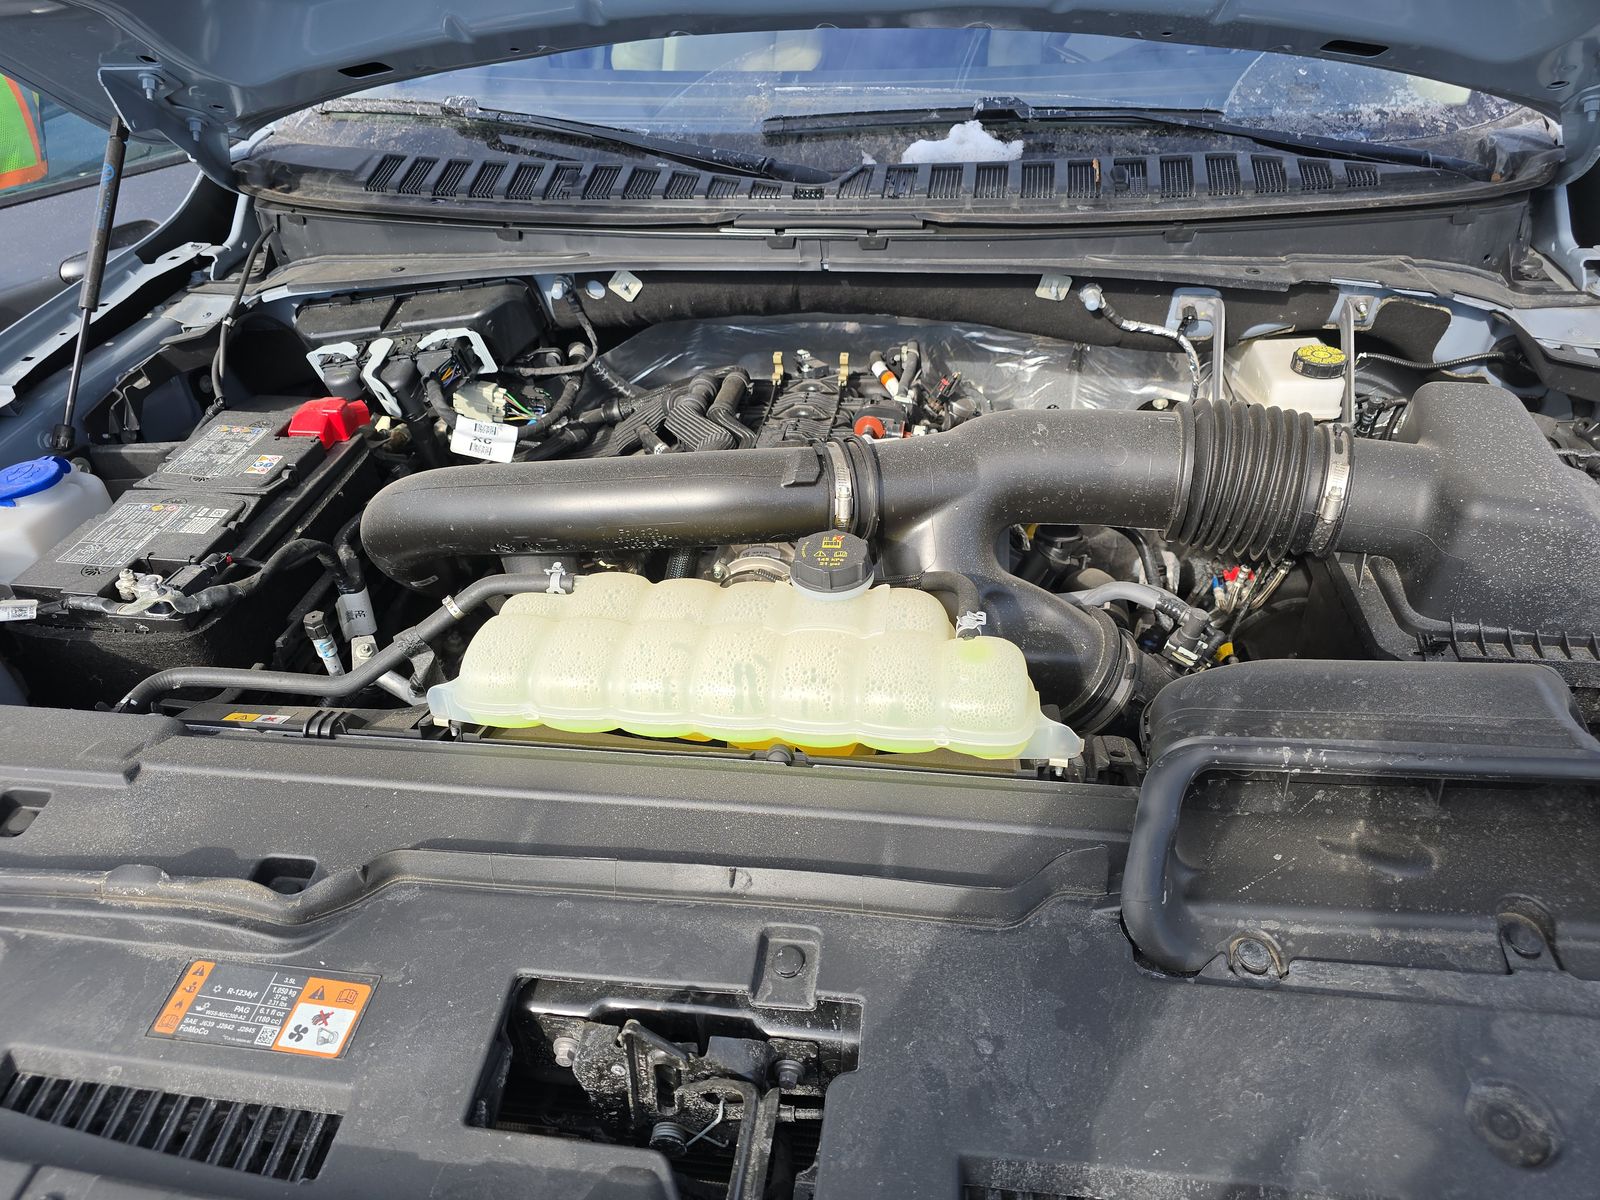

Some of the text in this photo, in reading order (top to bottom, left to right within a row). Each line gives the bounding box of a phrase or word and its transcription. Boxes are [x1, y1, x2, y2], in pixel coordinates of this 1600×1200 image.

[226, 987, 259, 999] R-1234yf
[272, 987, 297, 998] 1.050 kg
[234, 1005, 251, 1014] PAG
[259, 1007, 271, 1016] 6.1
[183, 1017, 198, 1025] SAE
[199, 1019, 215, 1028] J639
[255, 1014, 282, 1025] (180 cc)
[178, 1024, 209, 1035] FoMoCo
